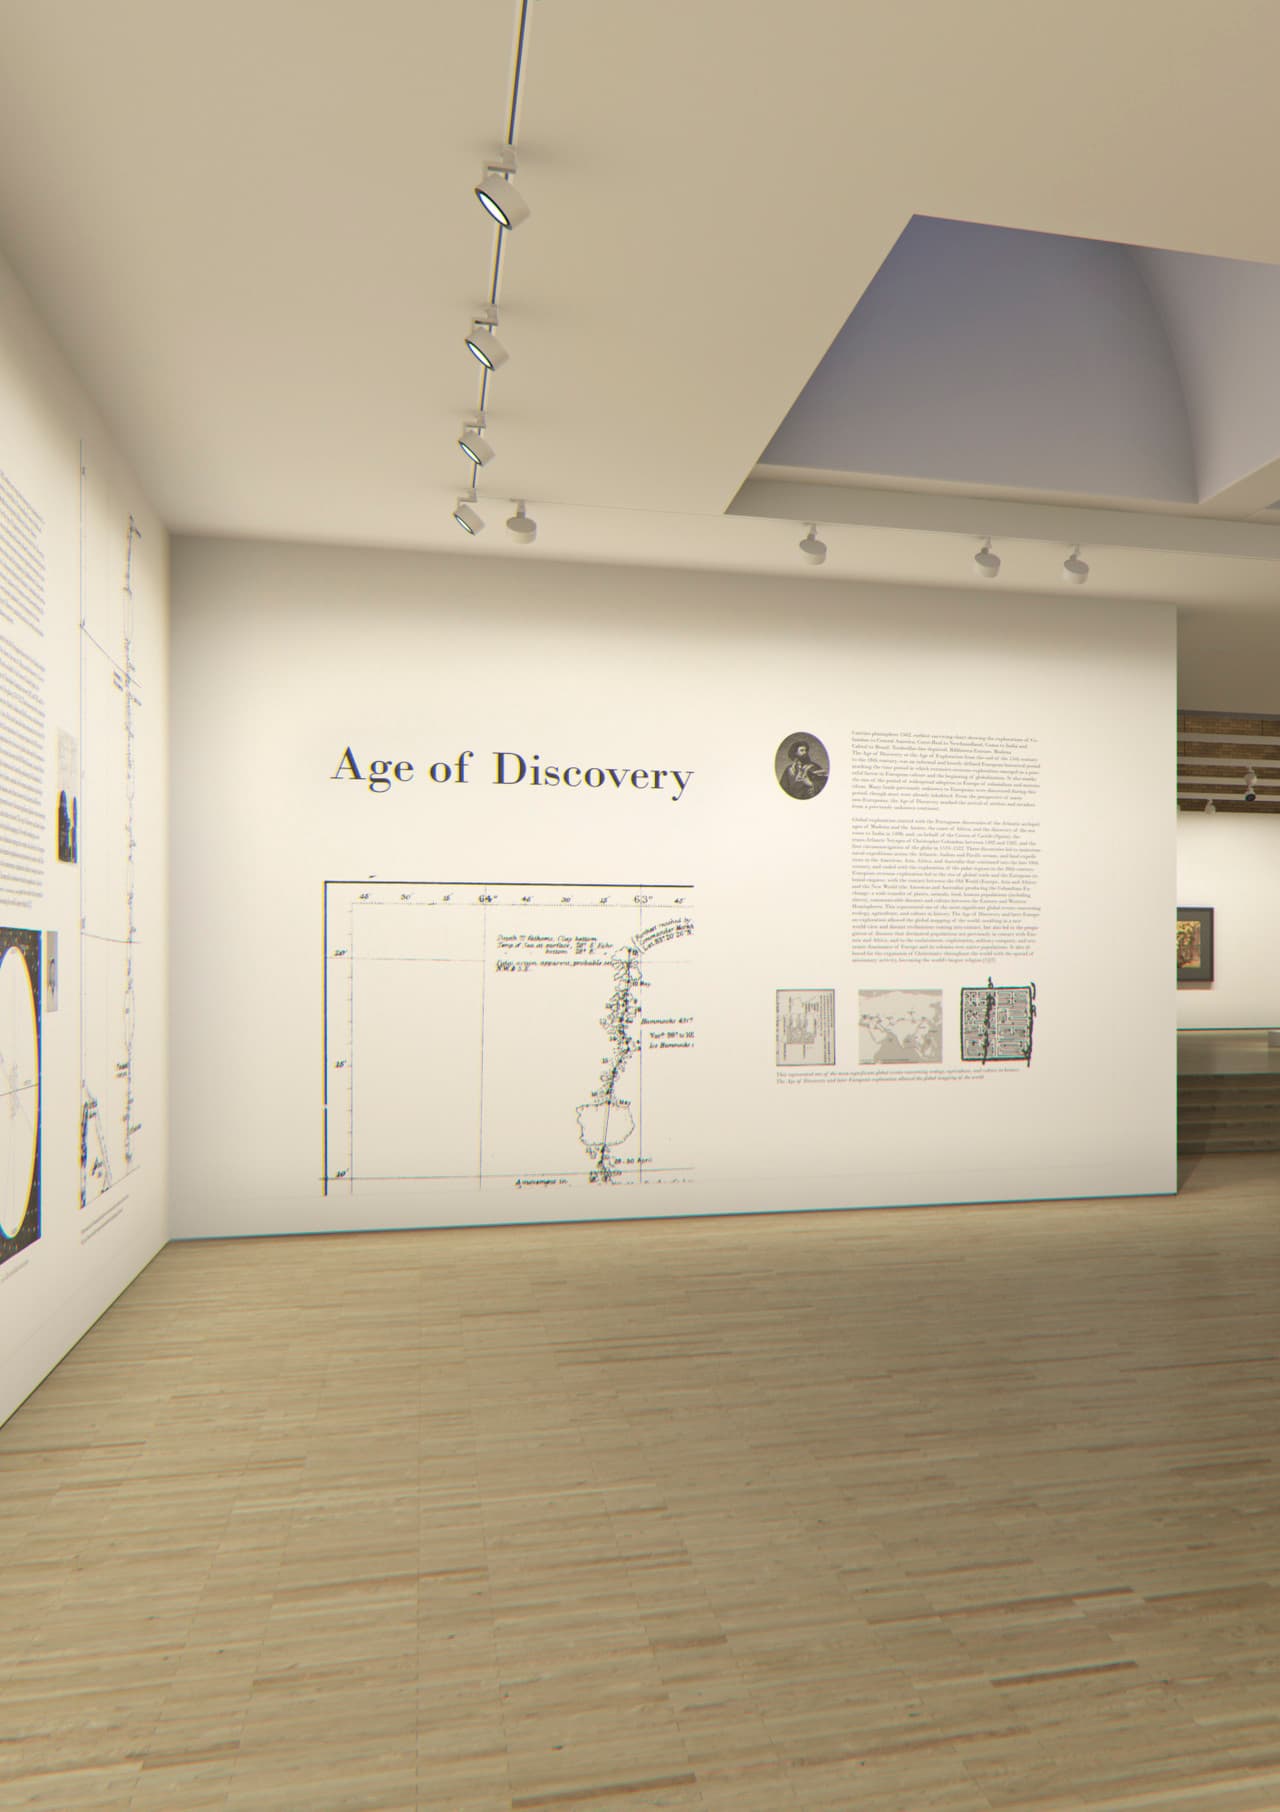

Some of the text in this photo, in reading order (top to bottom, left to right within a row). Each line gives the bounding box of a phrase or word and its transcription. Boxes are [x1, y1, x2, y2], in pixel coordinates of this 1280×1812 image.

[329, 746, 695, 801] Age of Discovery
